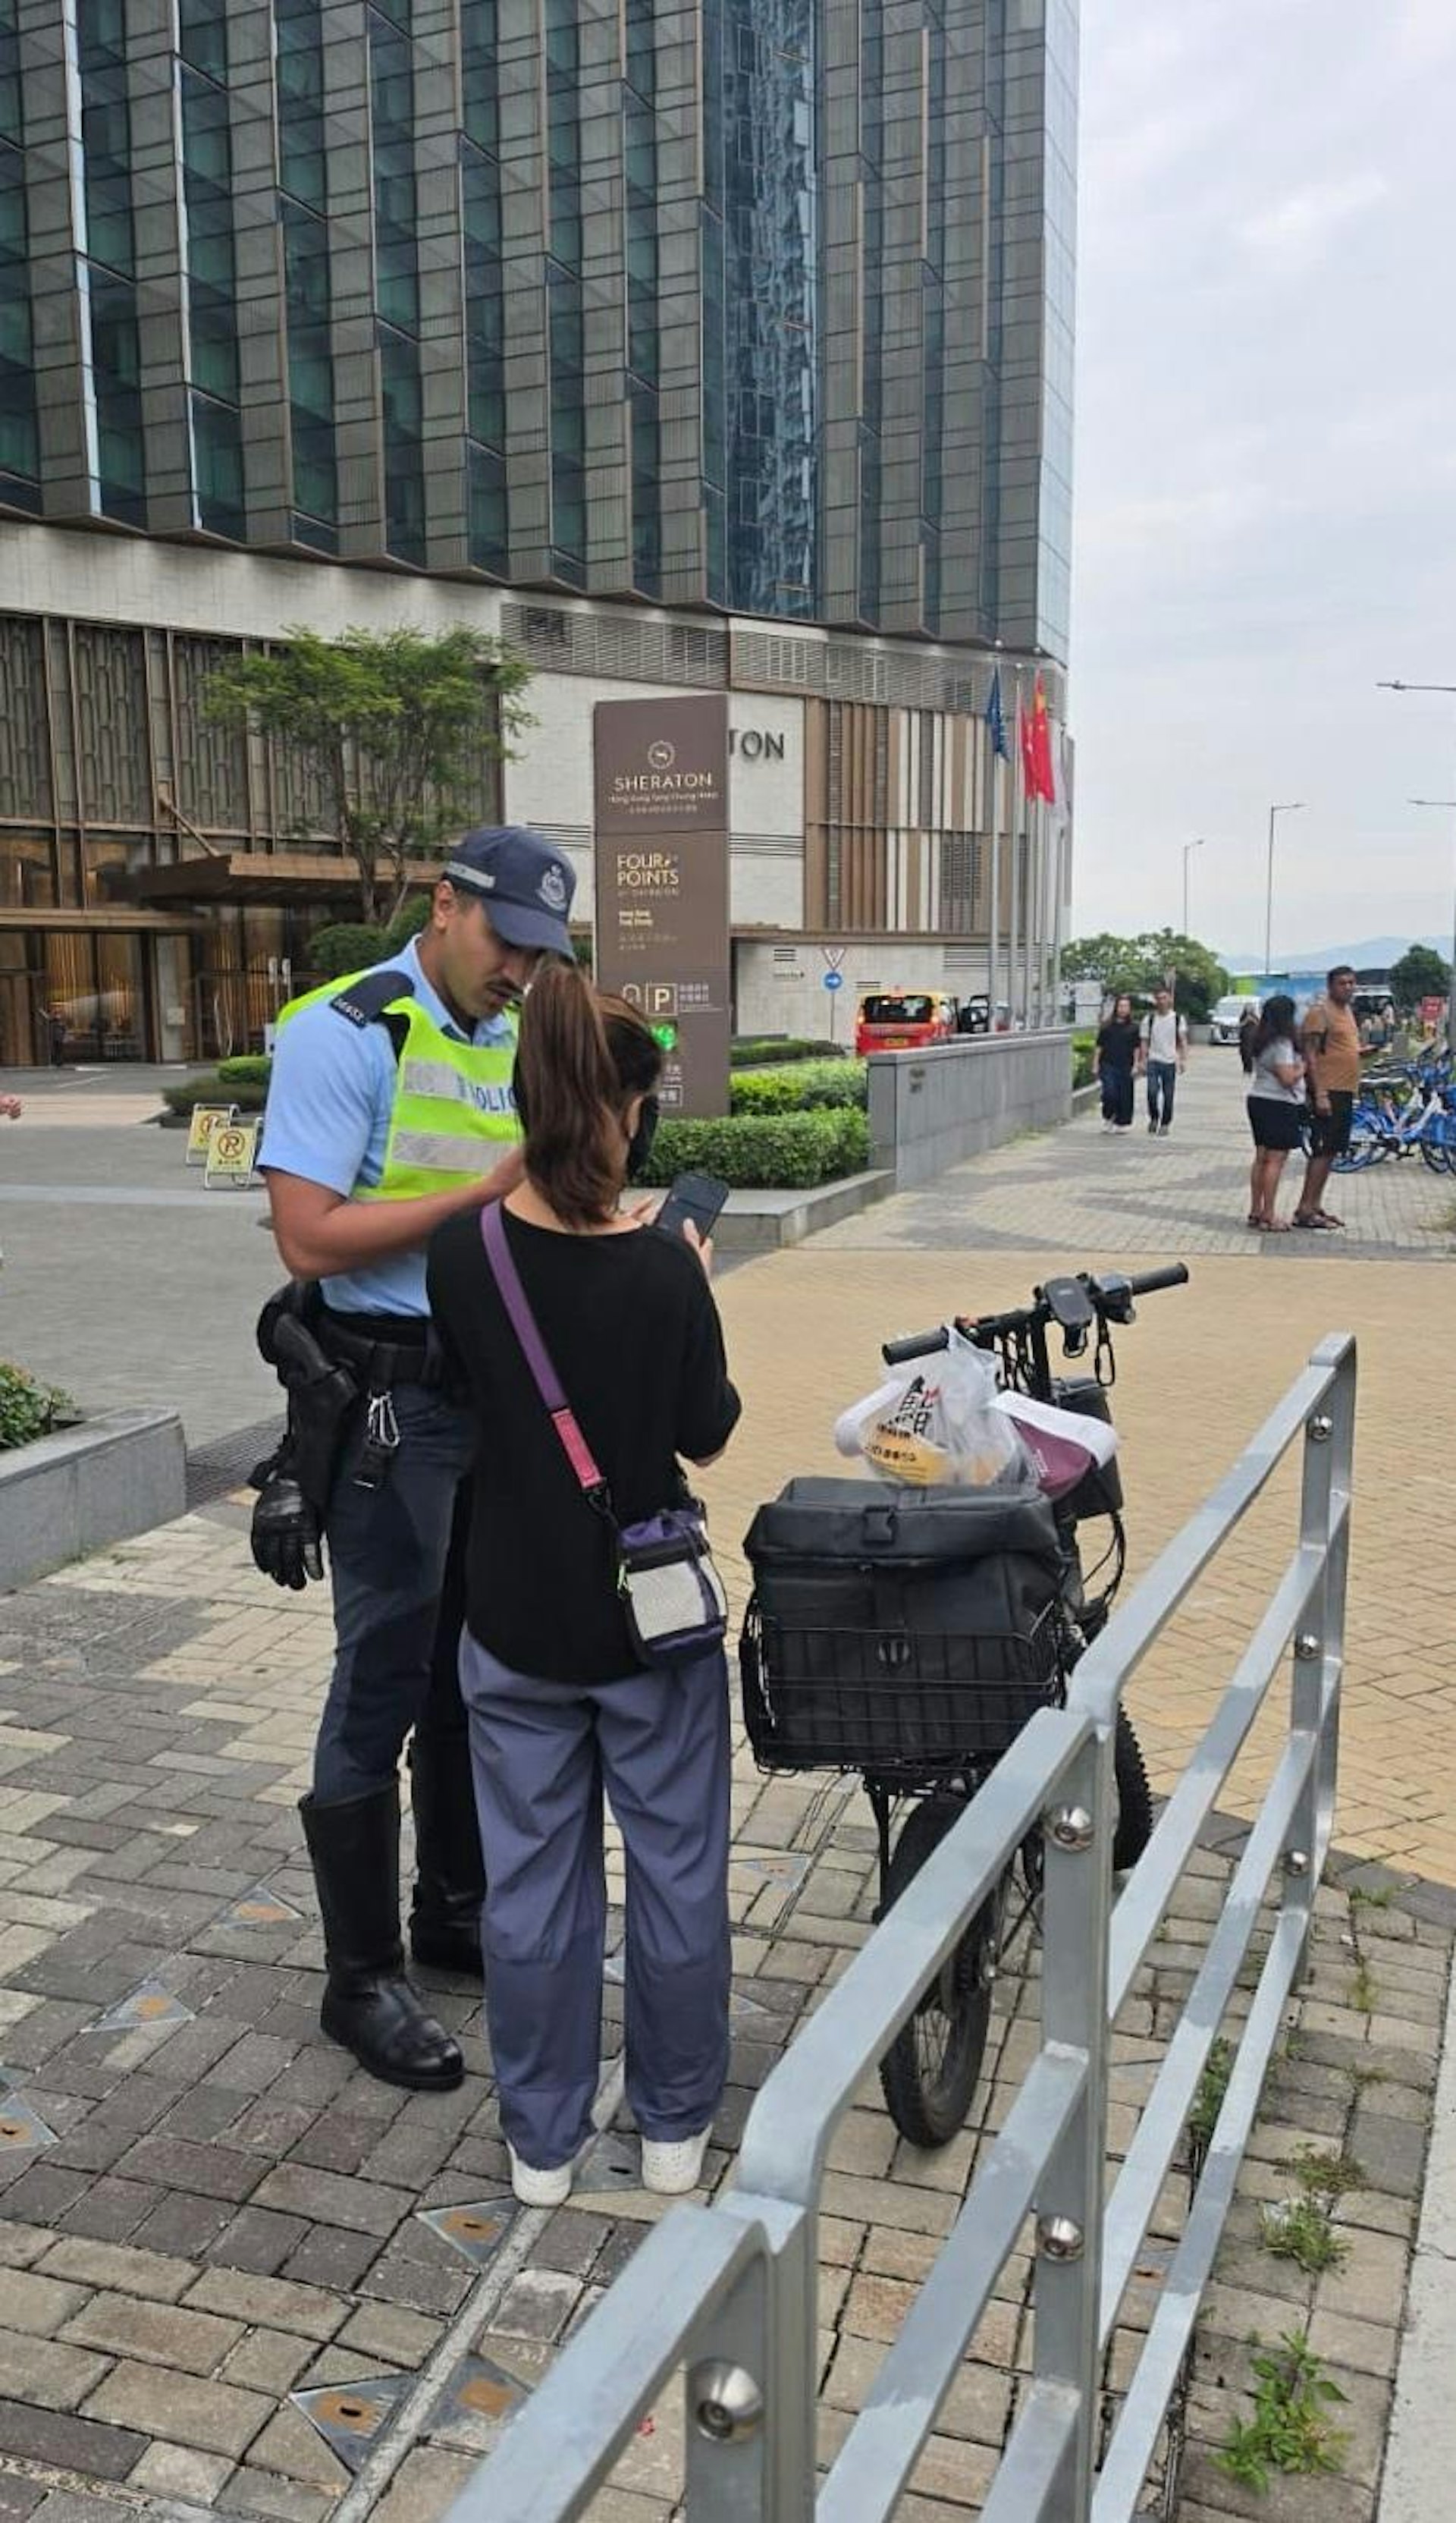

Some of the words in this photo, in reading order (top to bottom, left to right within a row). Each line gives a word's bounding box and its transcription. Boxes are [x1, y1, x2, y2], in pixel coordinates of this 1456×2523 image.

[615, 772, 712, 792] SHERATON
[617, 853, 664, 869] FOUR
[617, 869, 679, 887] POINTS
[654, 988, 670, 1011] P
